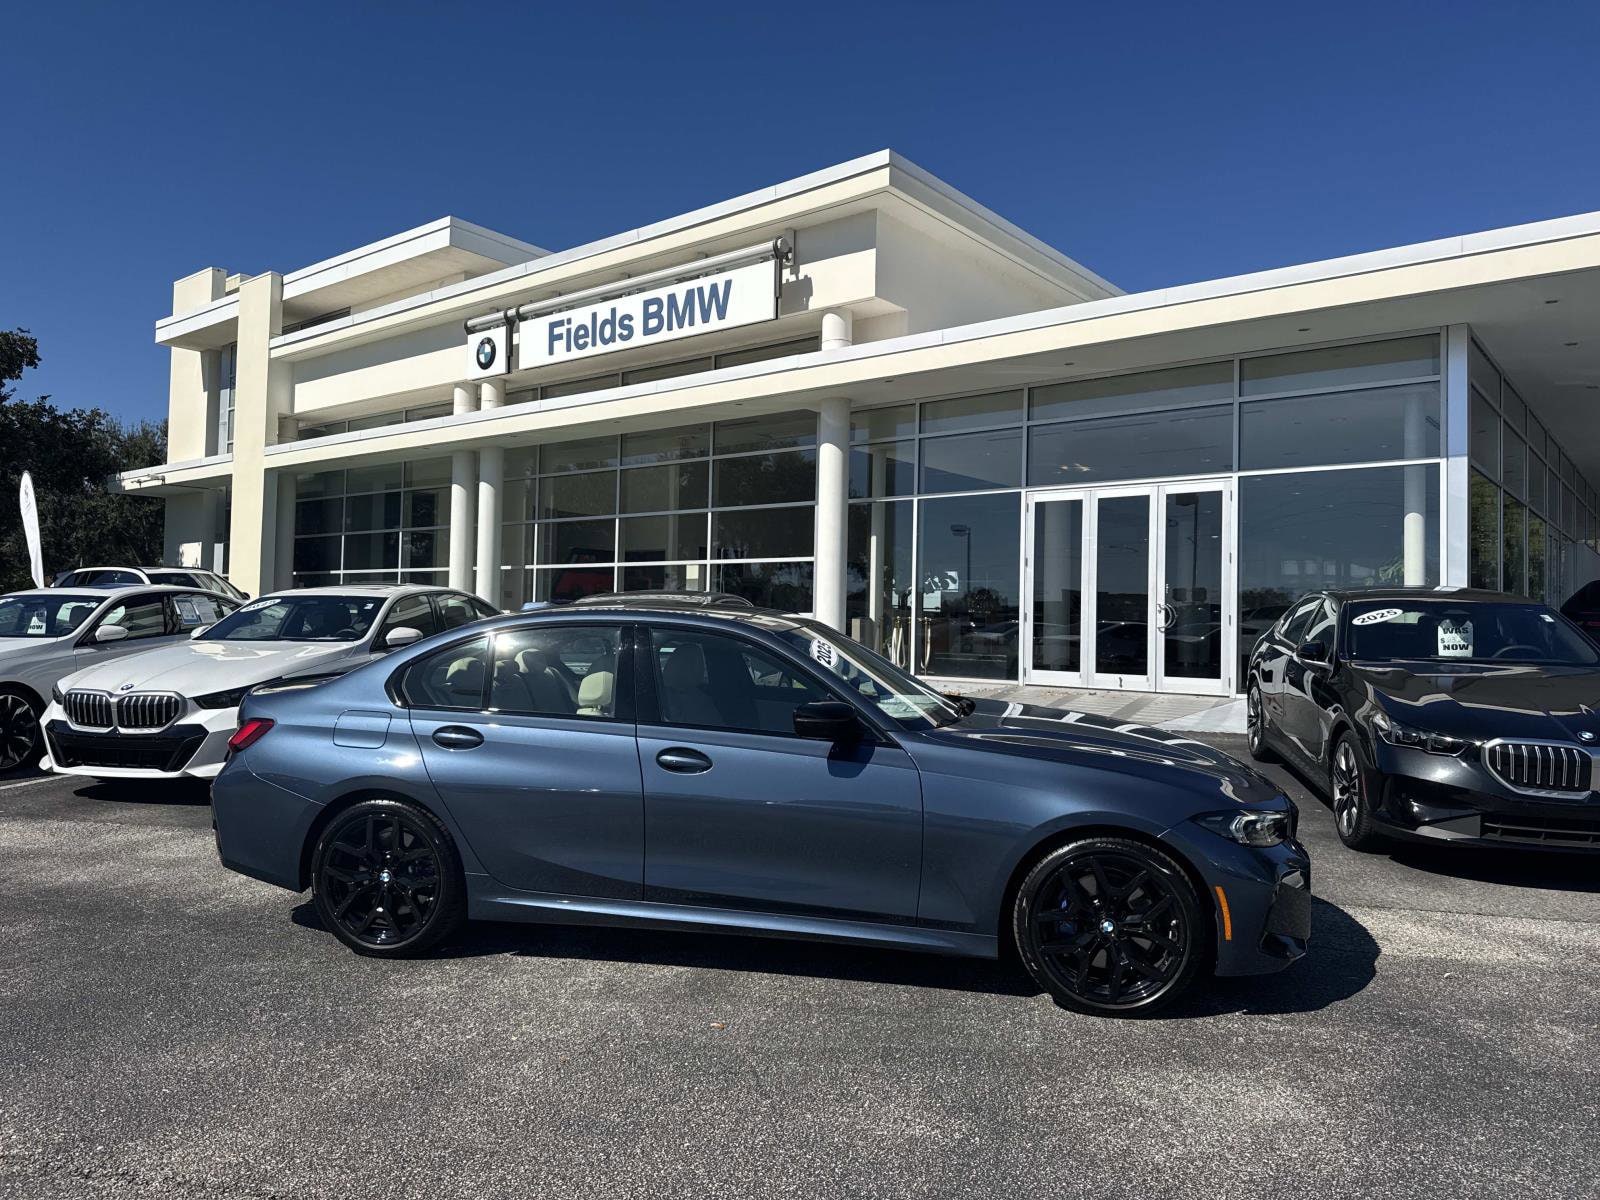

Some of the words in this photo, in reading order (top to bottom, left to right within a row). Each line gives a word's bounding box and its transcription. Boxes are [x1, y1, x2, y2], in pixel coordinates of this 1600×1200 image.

[548, 307, 635, 356] Fields
[642, 279, 732, 337] BMW
[1357, 609, 1397, 624] 2025
[1442, 627, 1469, 635] WAS
[817, 640, 832, 666] 2025
